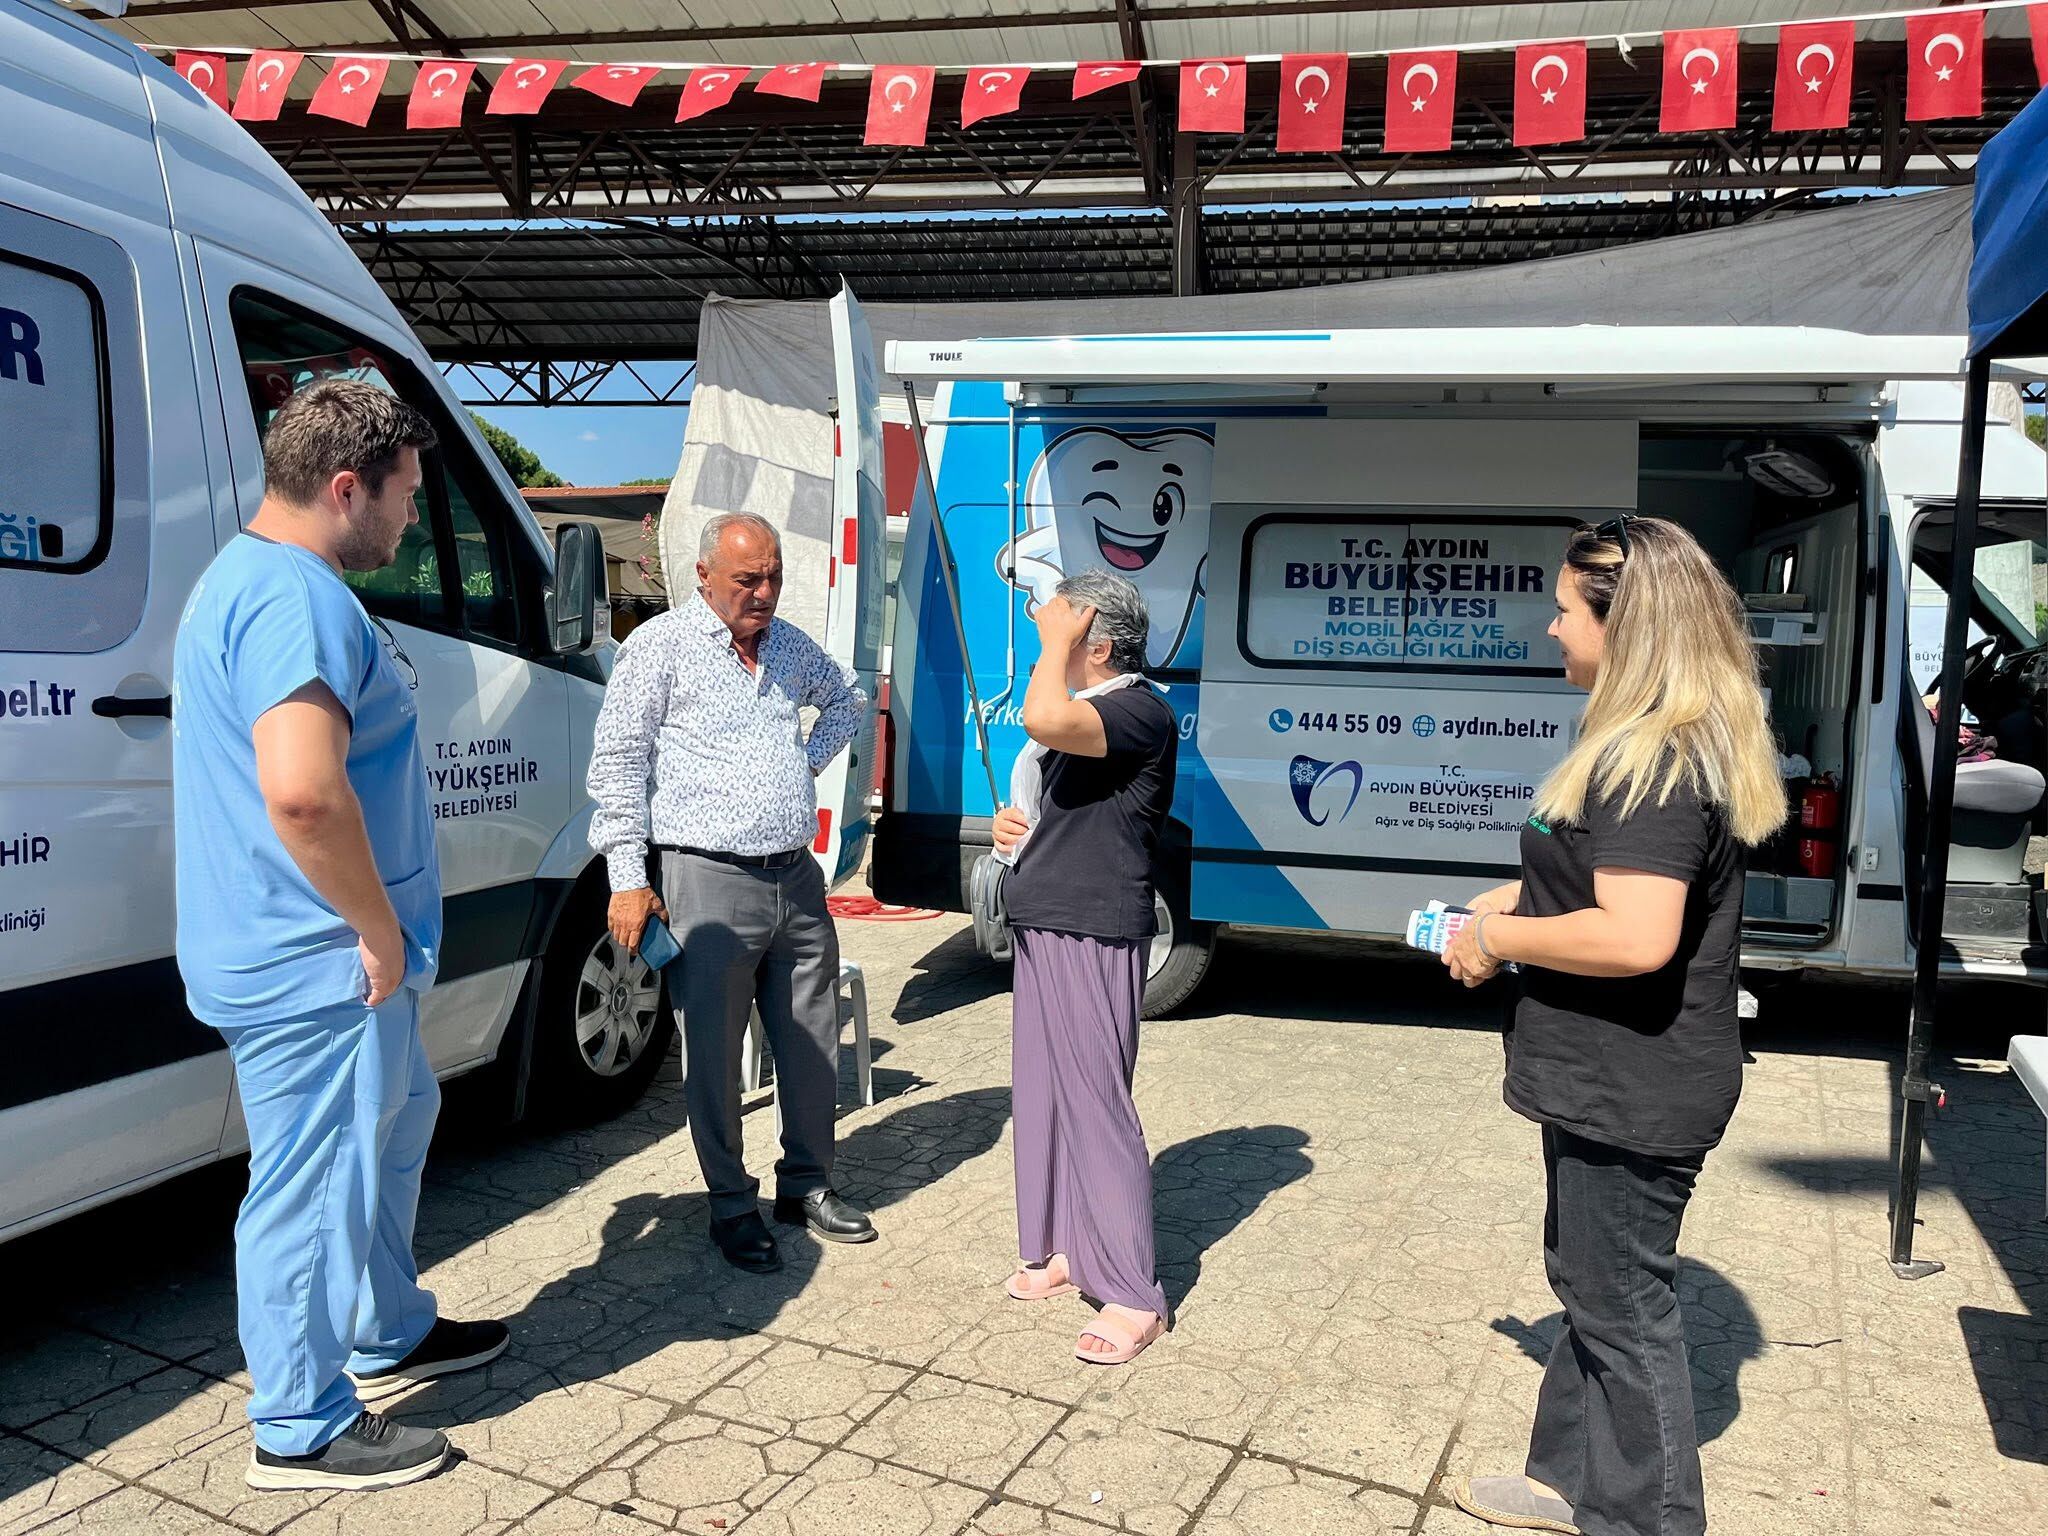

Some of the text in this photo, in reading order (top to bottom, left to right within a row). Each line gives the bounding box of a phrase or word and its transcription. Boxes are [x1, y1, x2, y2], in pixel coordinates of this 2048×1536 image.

[929, 352, 963, 361] THULE
[1341, 538, 1489, 559] T.C. AYDIN
[1285, 562, 1544, 595] BÜYÜKŞEHİR
[1327, 596, 1497, 619] BELEDİYESİ
[1324, 619, 1504, 640] MOBİL AĞIZ VE
[1293, 636, 1529, 660] DİŞ SAĞLIĞI KLİNİĞİ
[1298, 712, 1402, 735] 444 55 09
[1442, 716, 1559, 739] aydın.bel.tr
[435, 738, 512, 760] T.C. AYDIN
[1439, 764, 1465, 778] T.C.
[1370, 779, 1535, 802] AYDIN BÜYÜKŞEHİR
[1409, 801, 1493, 817] BELEDİYESİ
[1375, 816, 1399, 828] Ağız
[1402, 819, 1415, 827] ve
[1418, 818, 1435, 831] Diş
[1438, 819, 1475, 832] Sağlığı
